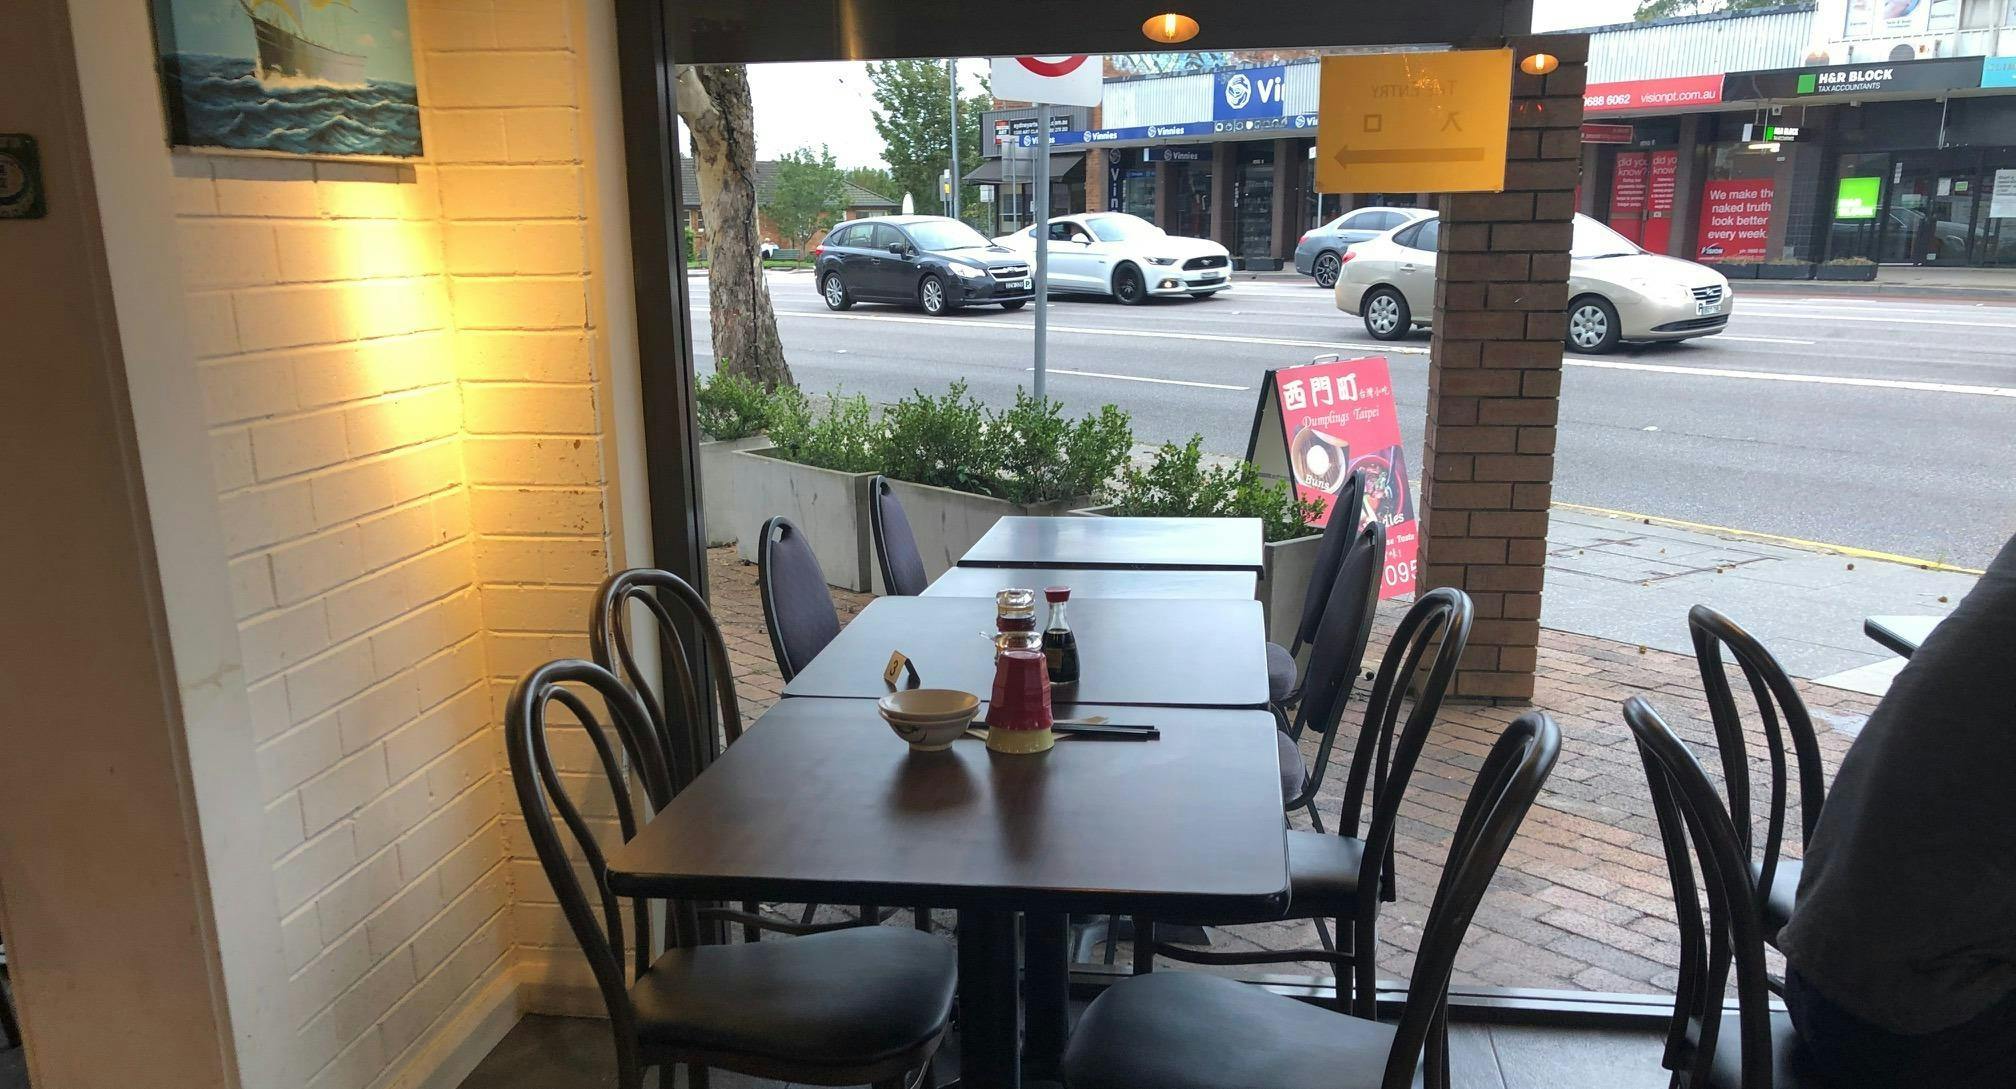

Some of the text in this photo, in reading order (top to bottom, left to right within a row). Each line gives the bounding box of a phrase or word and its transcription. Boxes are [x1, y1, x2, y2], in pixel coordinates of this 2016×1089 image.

[1818, 69, 1894, 84] H&R BLOCK
[1818, 82, 1881, 93] TAX ACCOUNTANTS
[1606, 94, 1631, 106] 6062
[1641, 90, 1716, 104] visionpt.com.au
[1092, 131, 1118, 141] Vinnies
[1157, 126, 1184, 136] Vinnies
[1173, 150, 1199, 160] Vinnies
[1710, 189, 1727, 200] We
[1729, 188, 1758, 199] make
[1712, 201, 1771, 213] naked truth
[1711, 215, 1768, 226] look better
[1708, 230, 1736, 241] every
[1282, 372, 1358, 411] 西門町
[1302, 405, 1380, 429] Dumplings Taipei
[1305, 473, 1330, 489] Buns
[889, 659, 899, 677] 3
